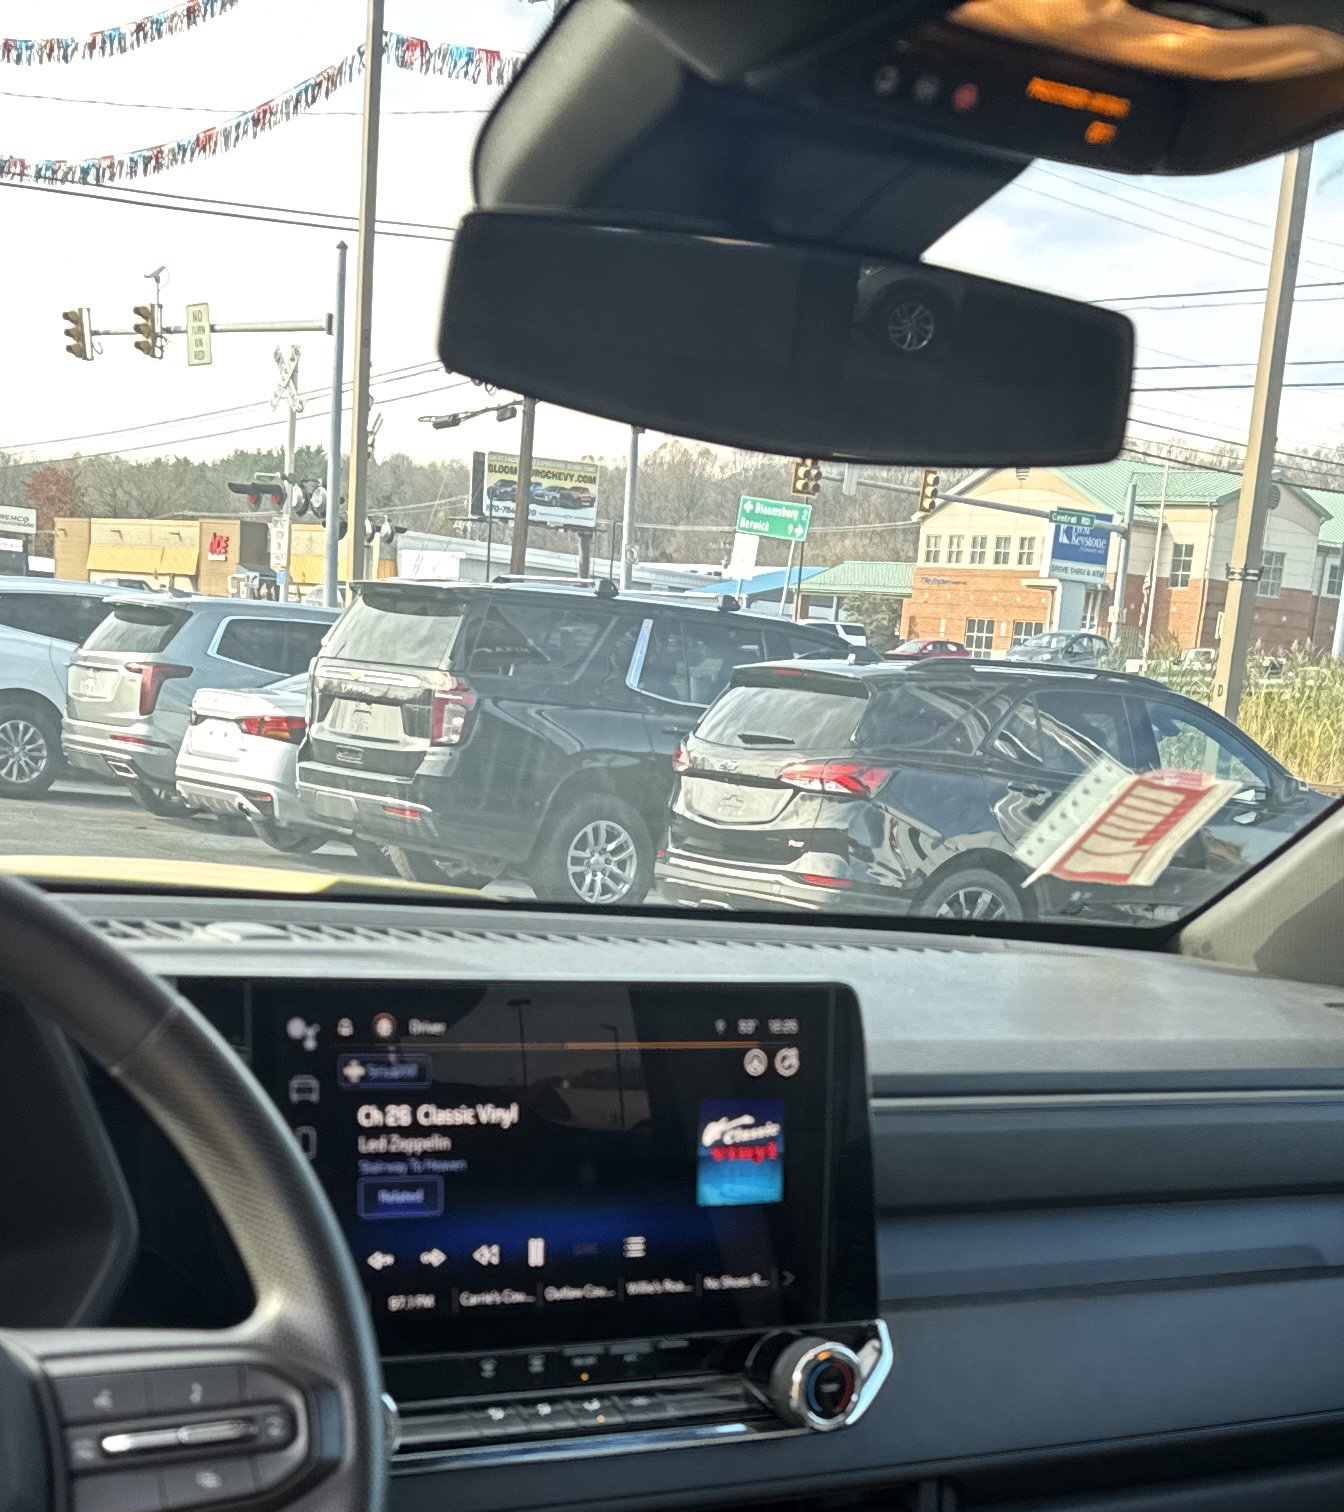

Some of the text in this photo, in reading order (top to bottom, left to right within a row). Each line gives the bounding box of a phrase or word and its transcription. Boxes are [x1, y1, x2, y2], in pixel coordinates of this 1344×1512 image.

[192, 310, 203, 322] NO
[191, 326, 206, 335] TURN
[194, 338, 204, 348] ON
[193, 350, 206, 360] RED
[802, 510, 809, 520] 2
[1051, 513, 1078, 524] Central
[739, 516, 770, 532] Berwick
[1070, 534, 1108, 550] Keystone
[1050, 564, 1069, 574] DRIVE
[357, 1104, 384, 1128] Ch
[416, 1103, 477, 1127] Classic
[476, 1101, 519, 1129] Vinyl
[357, 1132, 452, 1156] Led Zeppelin
